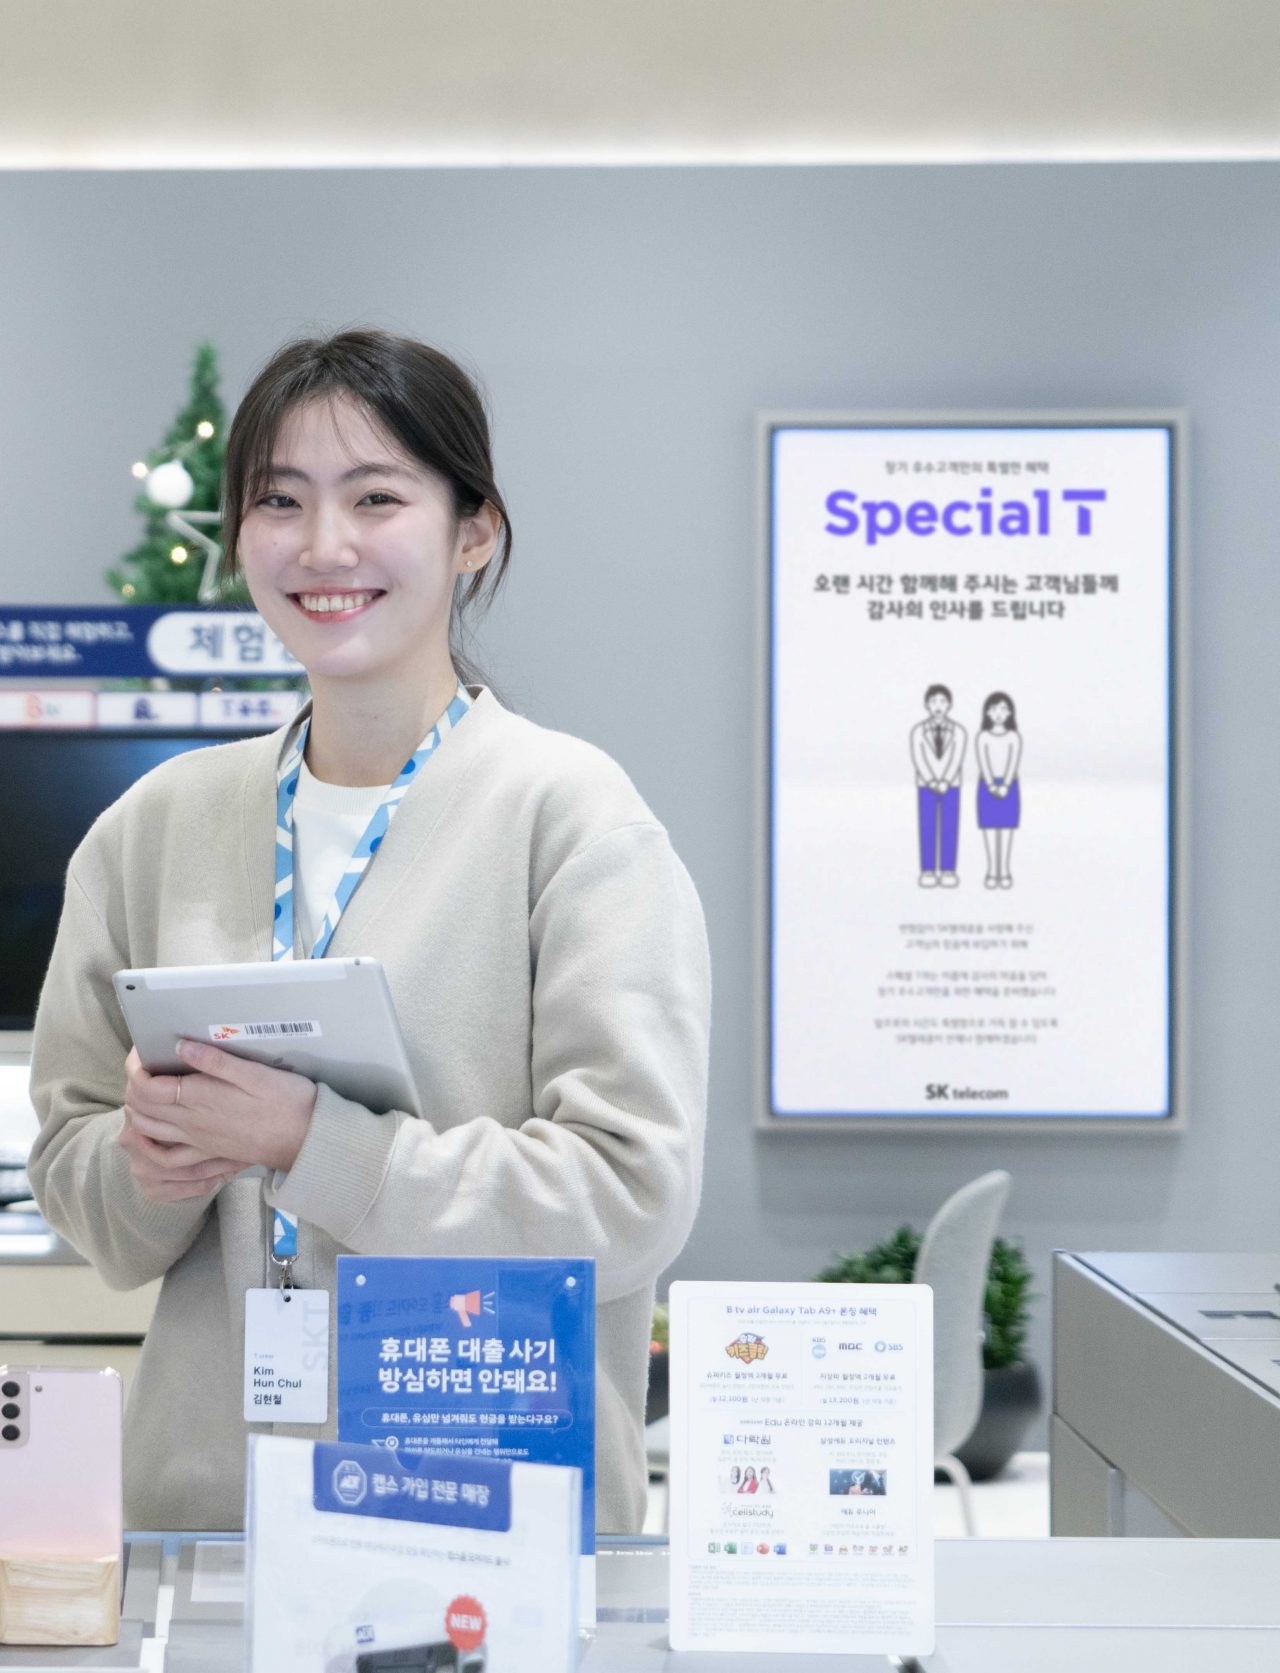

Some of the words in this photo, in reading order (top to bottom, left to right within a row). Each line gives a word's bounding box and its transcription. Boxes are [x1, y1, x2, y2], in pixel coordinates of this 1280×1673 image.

[825, 487, 1049, 546] Special
[1062, 489, 1106, 536] T
[814, 574, 851, 594] 오랜
[856, 574, 893, 594] 시간
[900, 574, 957, 594] 함께해
[963, 574, 1018, 594] 주시는
[1025, 574, 1119, 594] 고객님들께
[867, 600, 923, 620] 감사의
[929, 600, 983, 620] 인사를
[991, 600, 1065, 620] 드립니다
[925, 1084, 949, 1100] SK
[953, 1087, 1008, 1100] telecom
[763, 1306, 795, 1316] Galaxy
[799, 1307, 816, 1315] Tab
[379, 1337, 451, 1364] 휴대폰
[458, 1337, 505, 1364] 대출
[510, 1337, 556, 1364] 사기
[254, 1366, 274, 1375] Kim
[254, 1377, 274, 1387] Hun
[277, 1377, 302, 1388] Chul
[378, 1367, 473, 1393] 방심하면
[478, 1367, 557, 1393] 안돼요!
[254, 1394, 282, 1405] 김현철
[381, 1413, 410, 1424] 휴대폰,
[412, 1413, 440, 1424] 유심만
[508, 1414, 559, 1426] 받는다구요?
[400, 1475, 428, 1502] 가입
[431, 1478, 458, 1503] 전문
[460, 1482, 489, 1508] 매장
[449, 1613, 483, 1630] NEW
